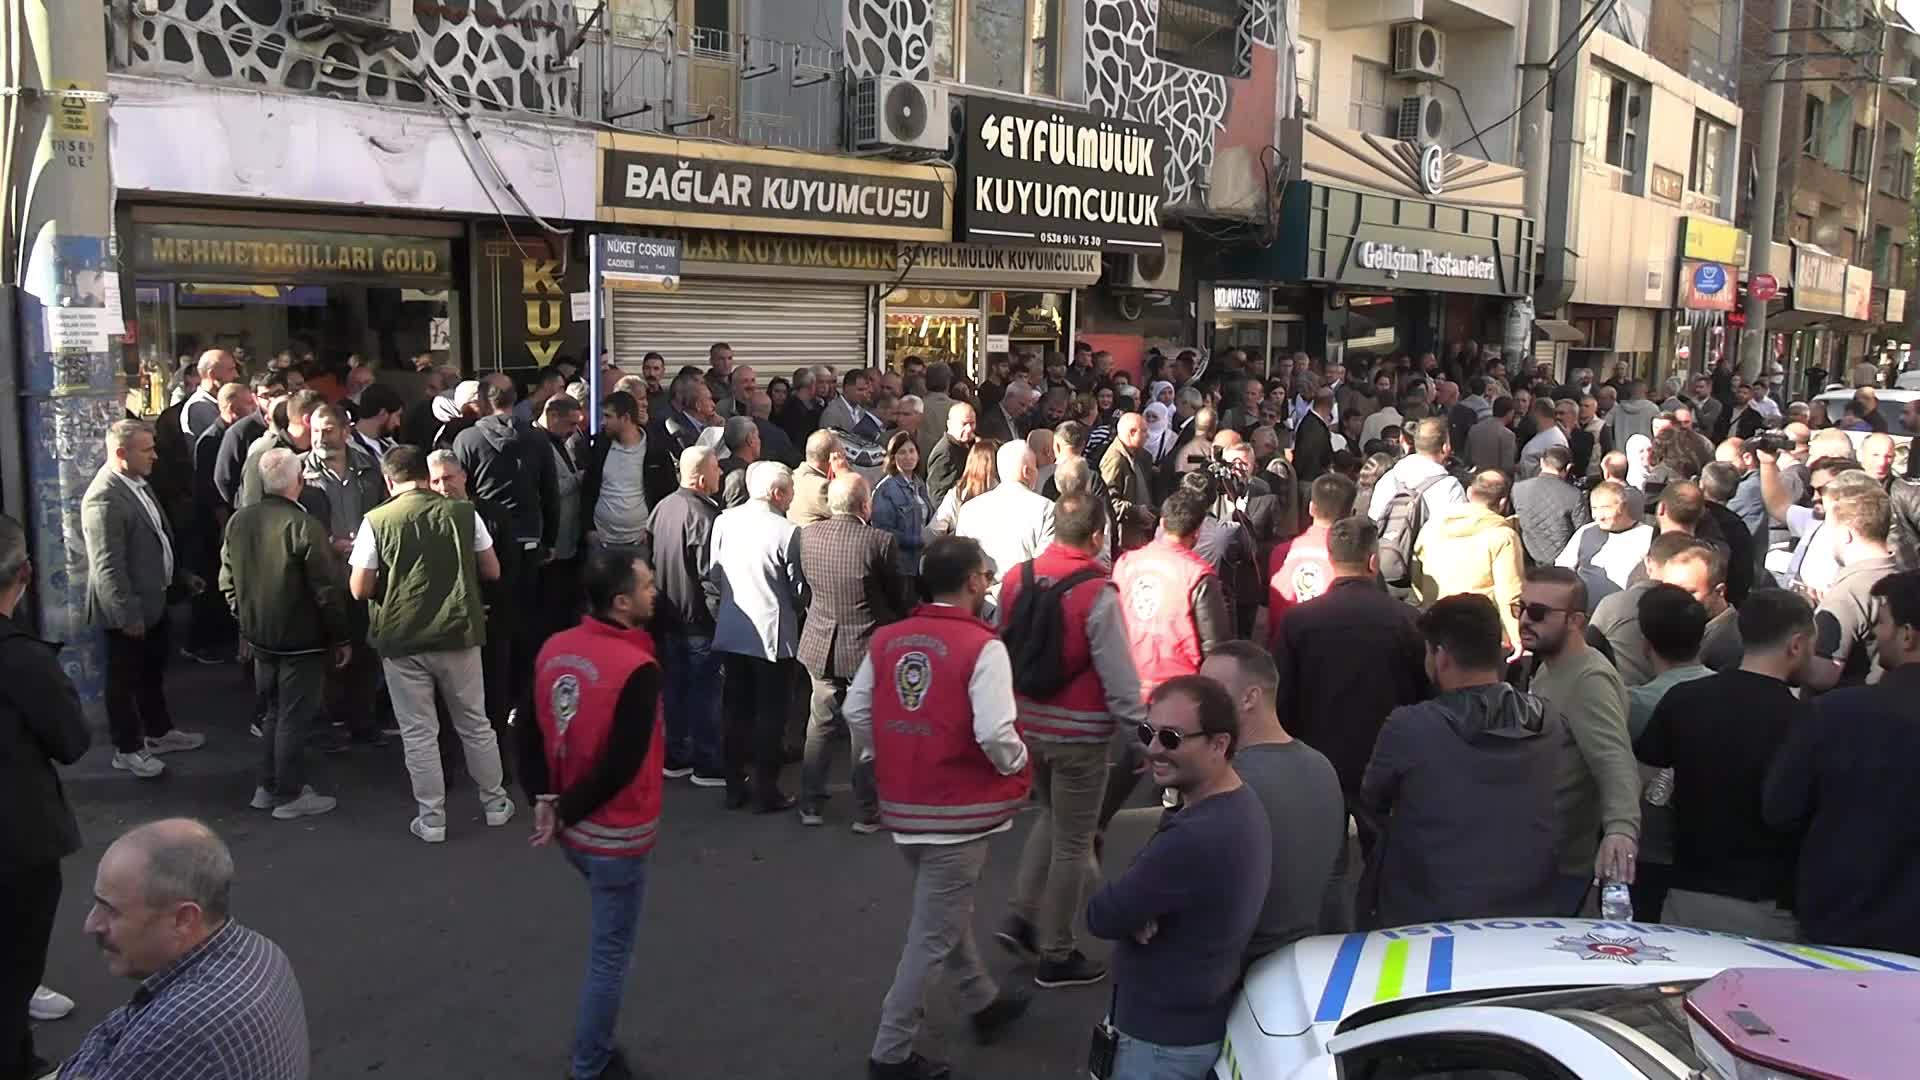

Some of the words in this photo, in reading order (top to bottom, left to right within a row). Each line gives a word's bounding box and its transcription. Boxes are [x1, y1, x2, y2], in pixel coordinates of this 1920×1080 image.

[981, 114, 1154, 177] SEYFÜLMÜLÜK
[625, 160, 752, 208] BAĞLAR
[762, 176, 930, 219] KUYUMCUSU
[976, 176, 1160, 227] KUYUMCULUK
[382, 247, 437, 273] GOLD
[607, 238, 637, 255] NÜKET
[638, 242, 676, 258] COŞKUN
[1009, 250, 1095, 273] KUYUMCULUK
[1362, 240, 1418, 279] Gelişim
[1421, 249, 1495, 280] Pastaneleri
